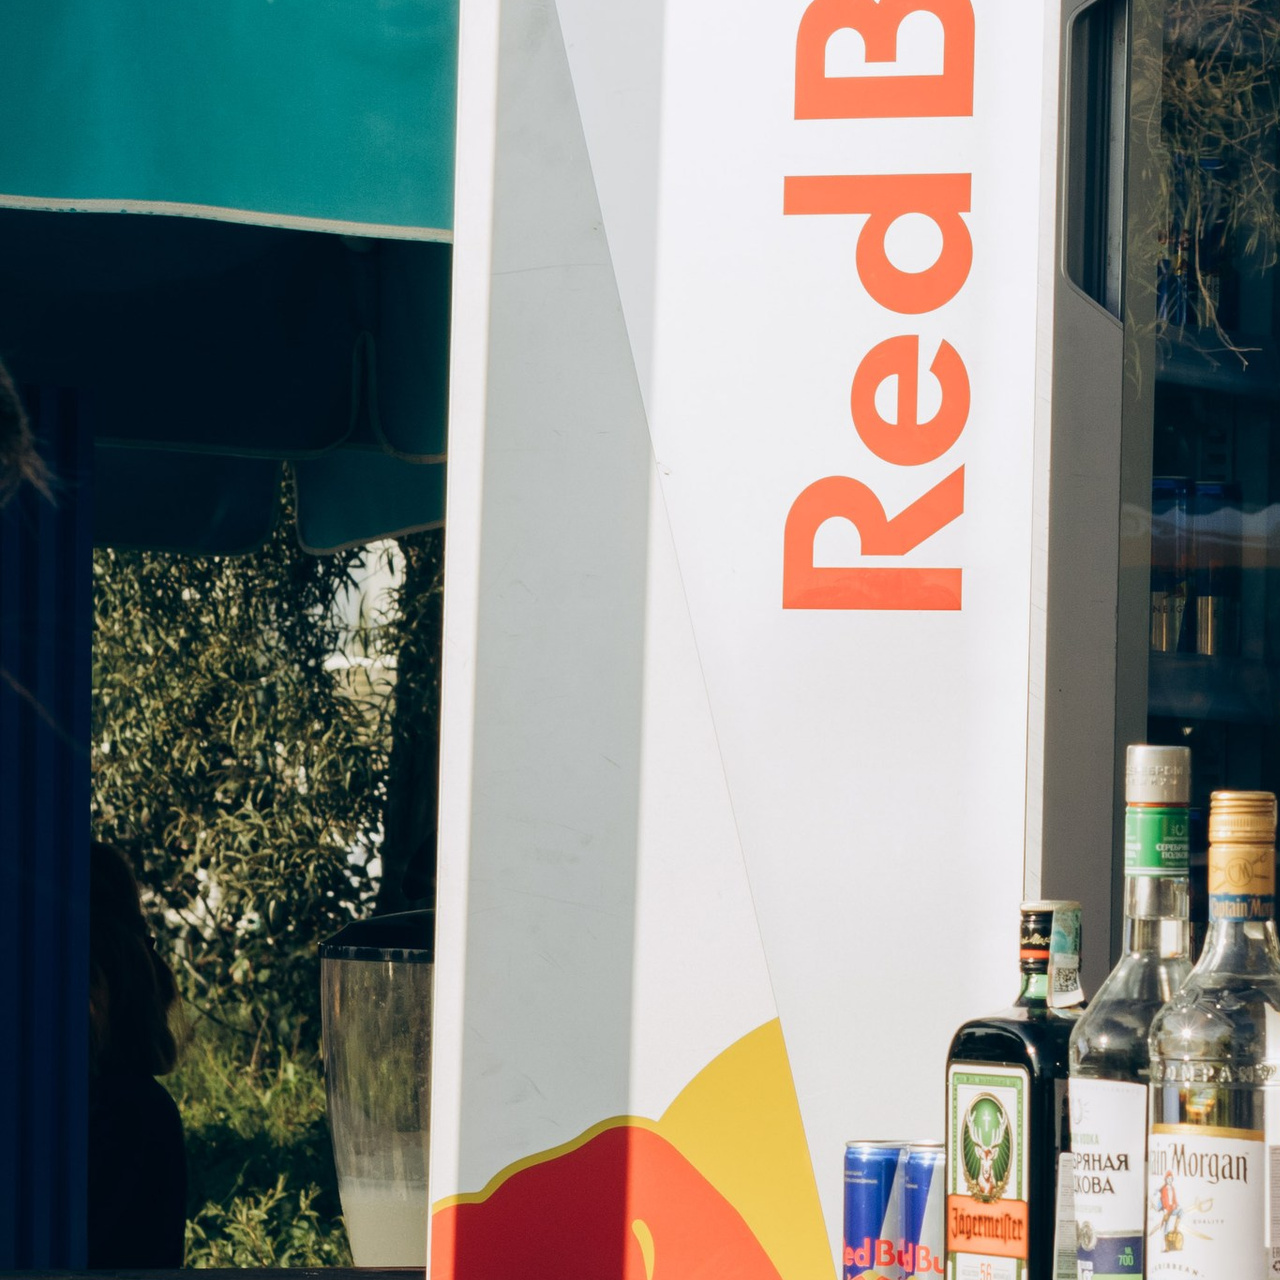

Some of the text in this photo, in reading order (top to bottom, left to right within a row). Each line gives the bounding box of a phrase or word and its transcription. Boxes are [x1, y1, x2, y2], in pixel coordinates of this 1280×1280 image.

[781, 170, 974, 612] Red
[1168, 1142, 1248, 1185] Morgan
[1118, 1255, 1134, 1266] 700
